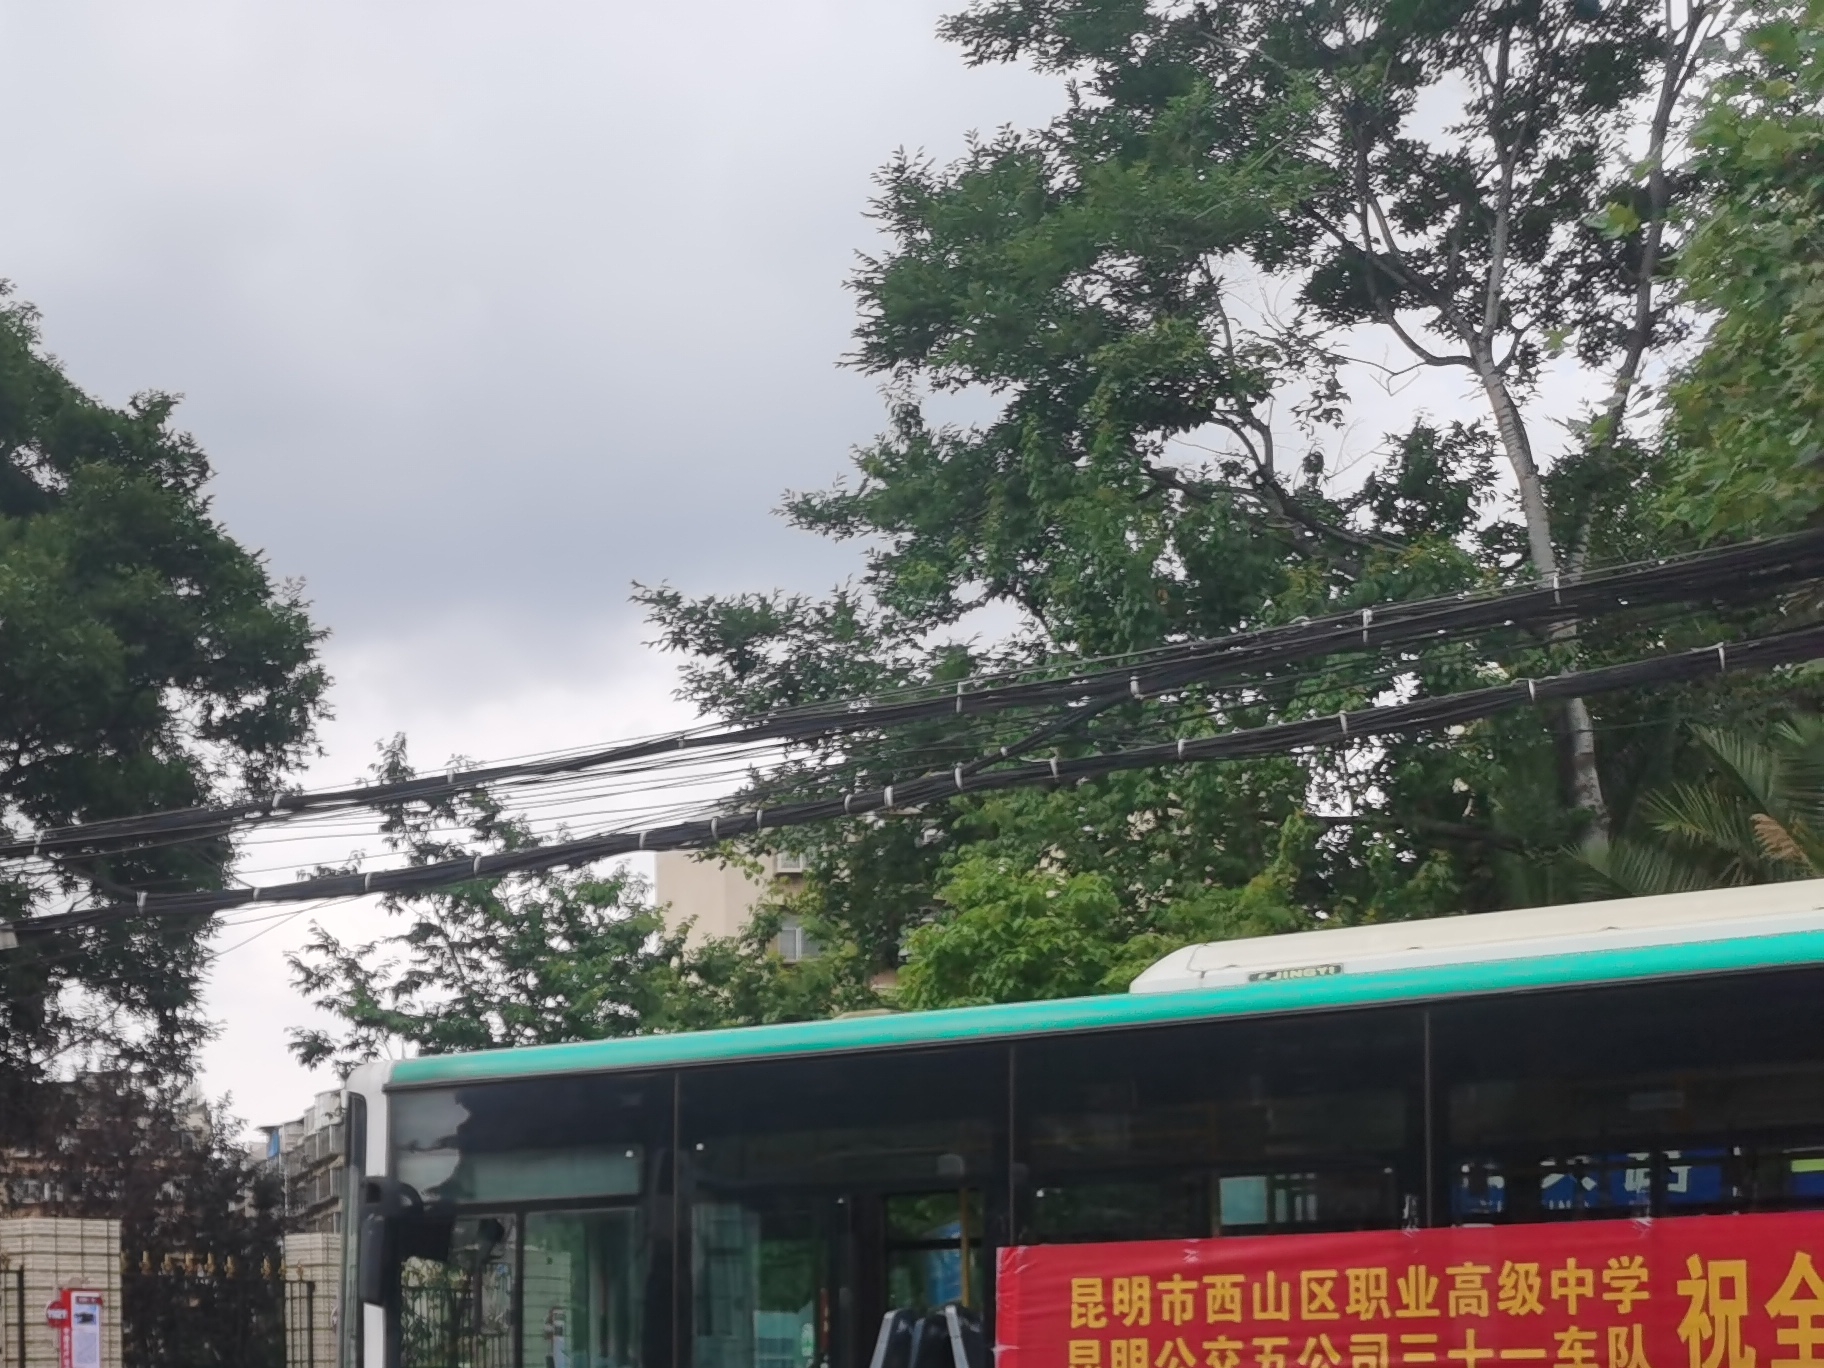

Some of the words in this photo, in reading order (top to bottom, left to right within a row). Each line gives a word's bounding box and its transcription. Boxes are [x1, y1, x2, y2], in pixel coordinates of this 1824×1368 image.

[1070, 1255, 1651, 1329] 昆明市西山区职业高级中学
